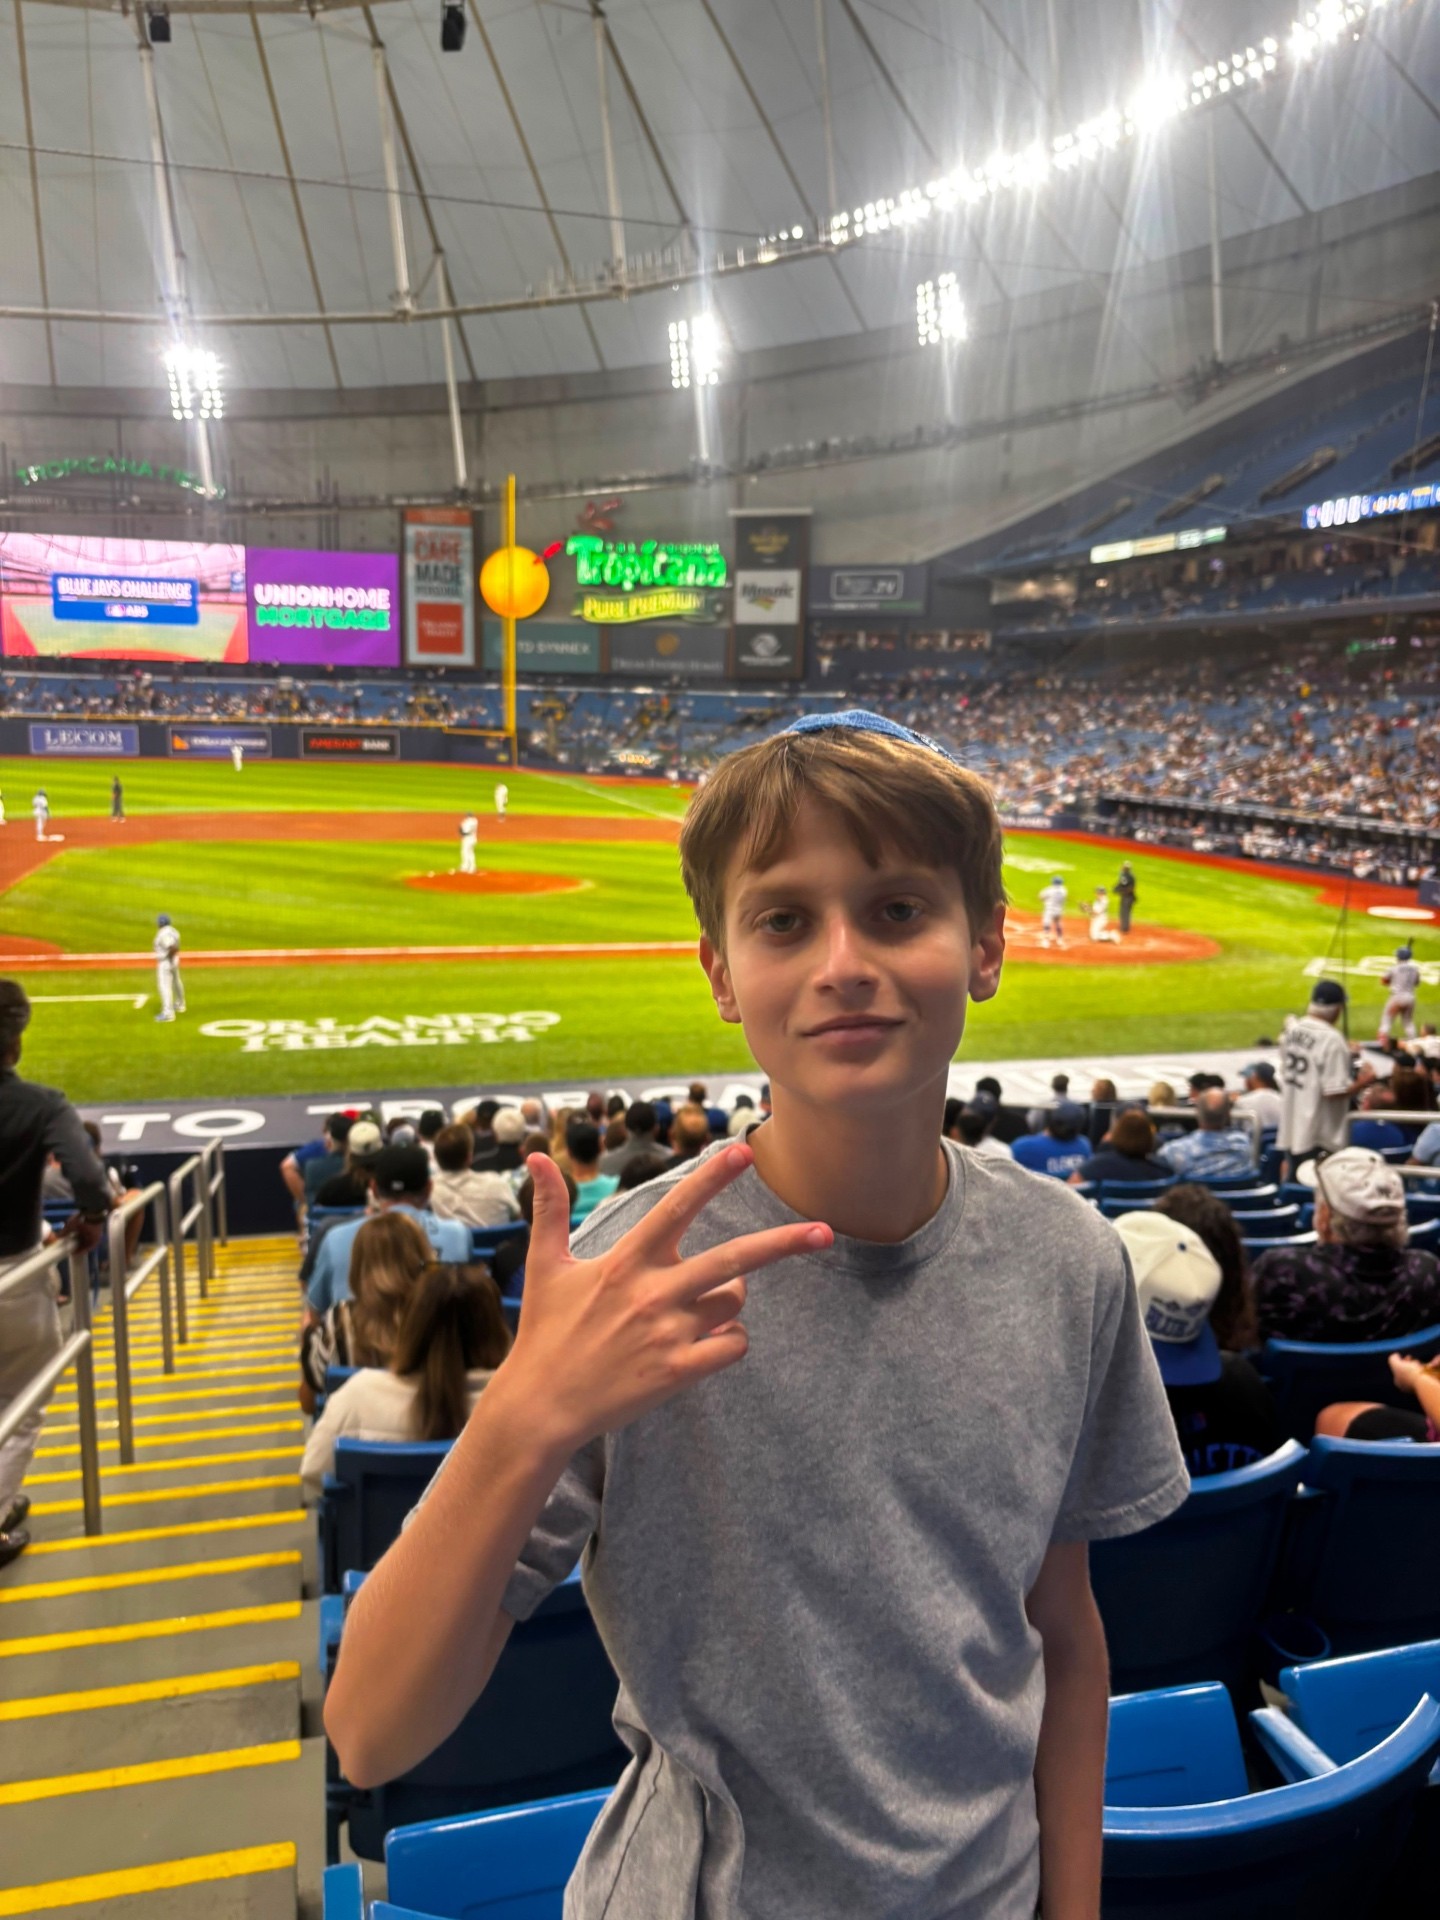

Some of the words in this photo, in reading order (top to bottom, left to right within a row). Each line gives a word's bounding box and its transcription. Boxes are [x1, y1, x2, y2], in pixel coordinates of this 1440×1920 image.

[416, 564, 462, 585] MADE
[566, 535, 727, 591] Tropicana
[57, 577, 92, 596] BLUE
[121, 580, 193, 600] CHALLENGE
[256, 606, 391, 631] MORTGAGE
[44, 729, 123, 746] LECOM
[200, 1011, 561, 1037] ORLANDO
[241, 1026, 536, 1052] HEALTH
[102, 1109, 266, 1140] TO
